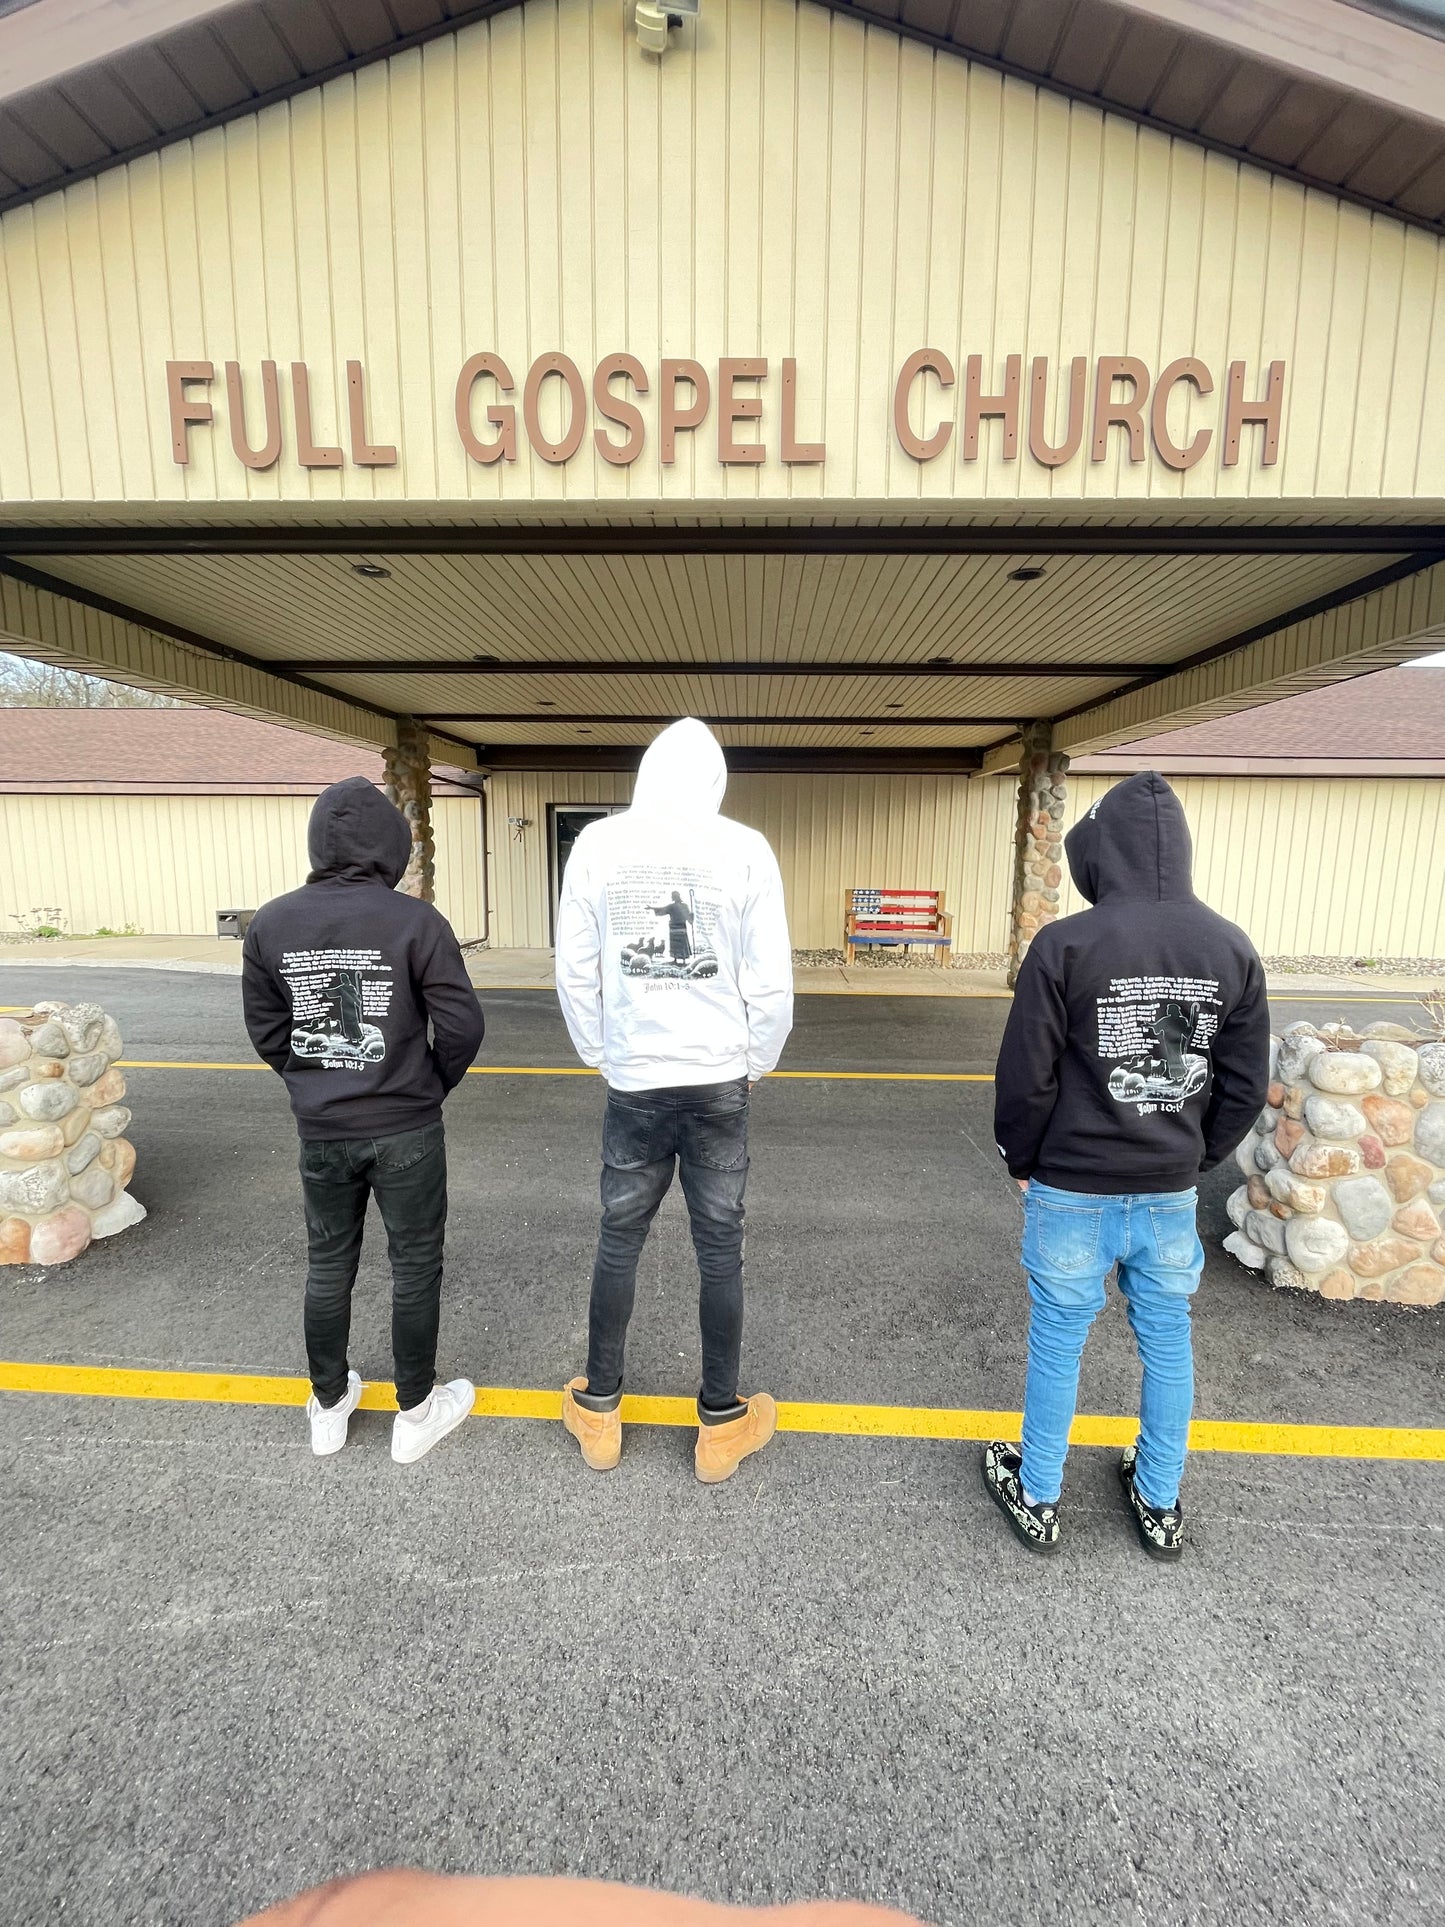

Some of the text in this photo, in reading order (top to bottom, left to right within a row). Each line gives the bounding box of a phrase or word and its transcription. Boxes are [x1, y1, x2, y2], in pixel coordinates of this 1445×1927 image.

[166, 348, 1286, 470] FULL GOSPEL CHURCH
[644, 982, 690, 993] John 10:1-5
[321, 1060, 365, 1071] John 10:1-5
[1137, 1103, 1158, 1116] John
